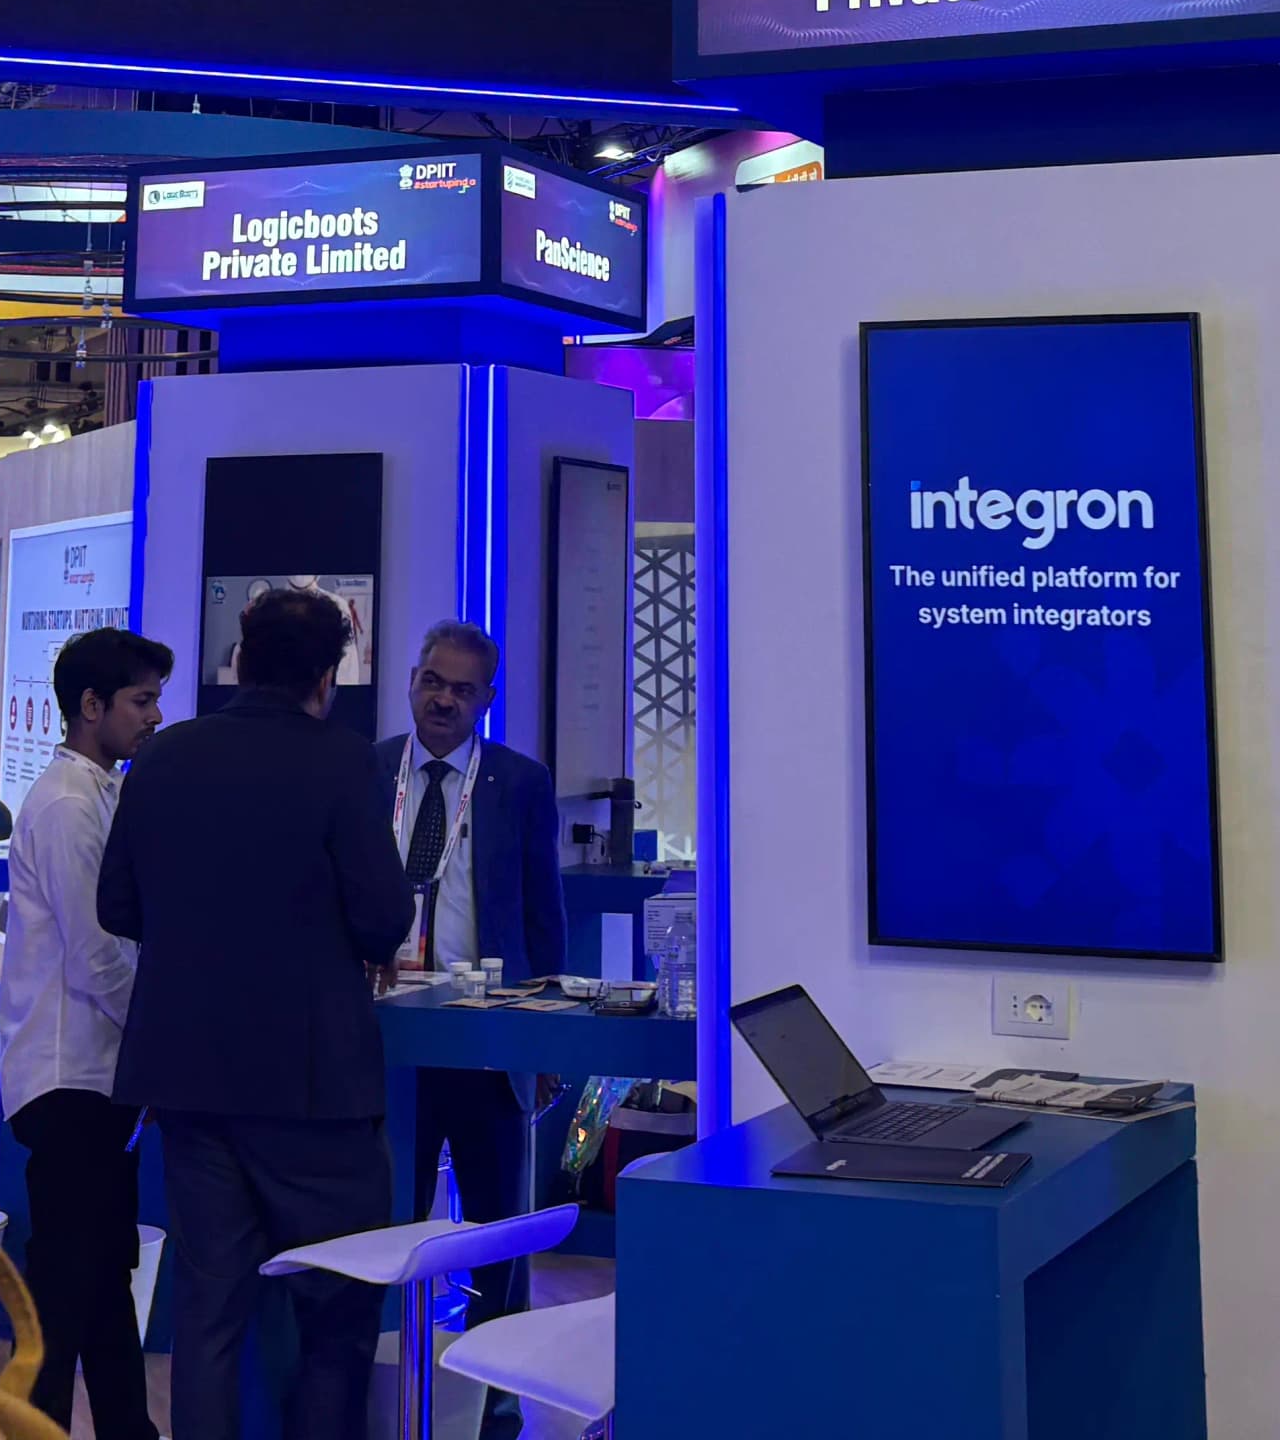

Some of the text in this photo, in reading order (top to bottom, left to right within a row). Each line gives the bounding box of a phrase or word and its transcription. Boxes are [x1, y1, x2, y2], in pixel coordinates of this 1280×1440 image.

[416, 162, 456, 180] DPIIT
[232, 207, 378, 248] Logicboots
[202, 240, 406, 281] Private Limited
[535, 228, 610, 282] PanScience
[910, 476, 1154, 550] integron
[890, 565, 1181, 592] The unified platform for
[919, 603, 1152, 631] system integrators
